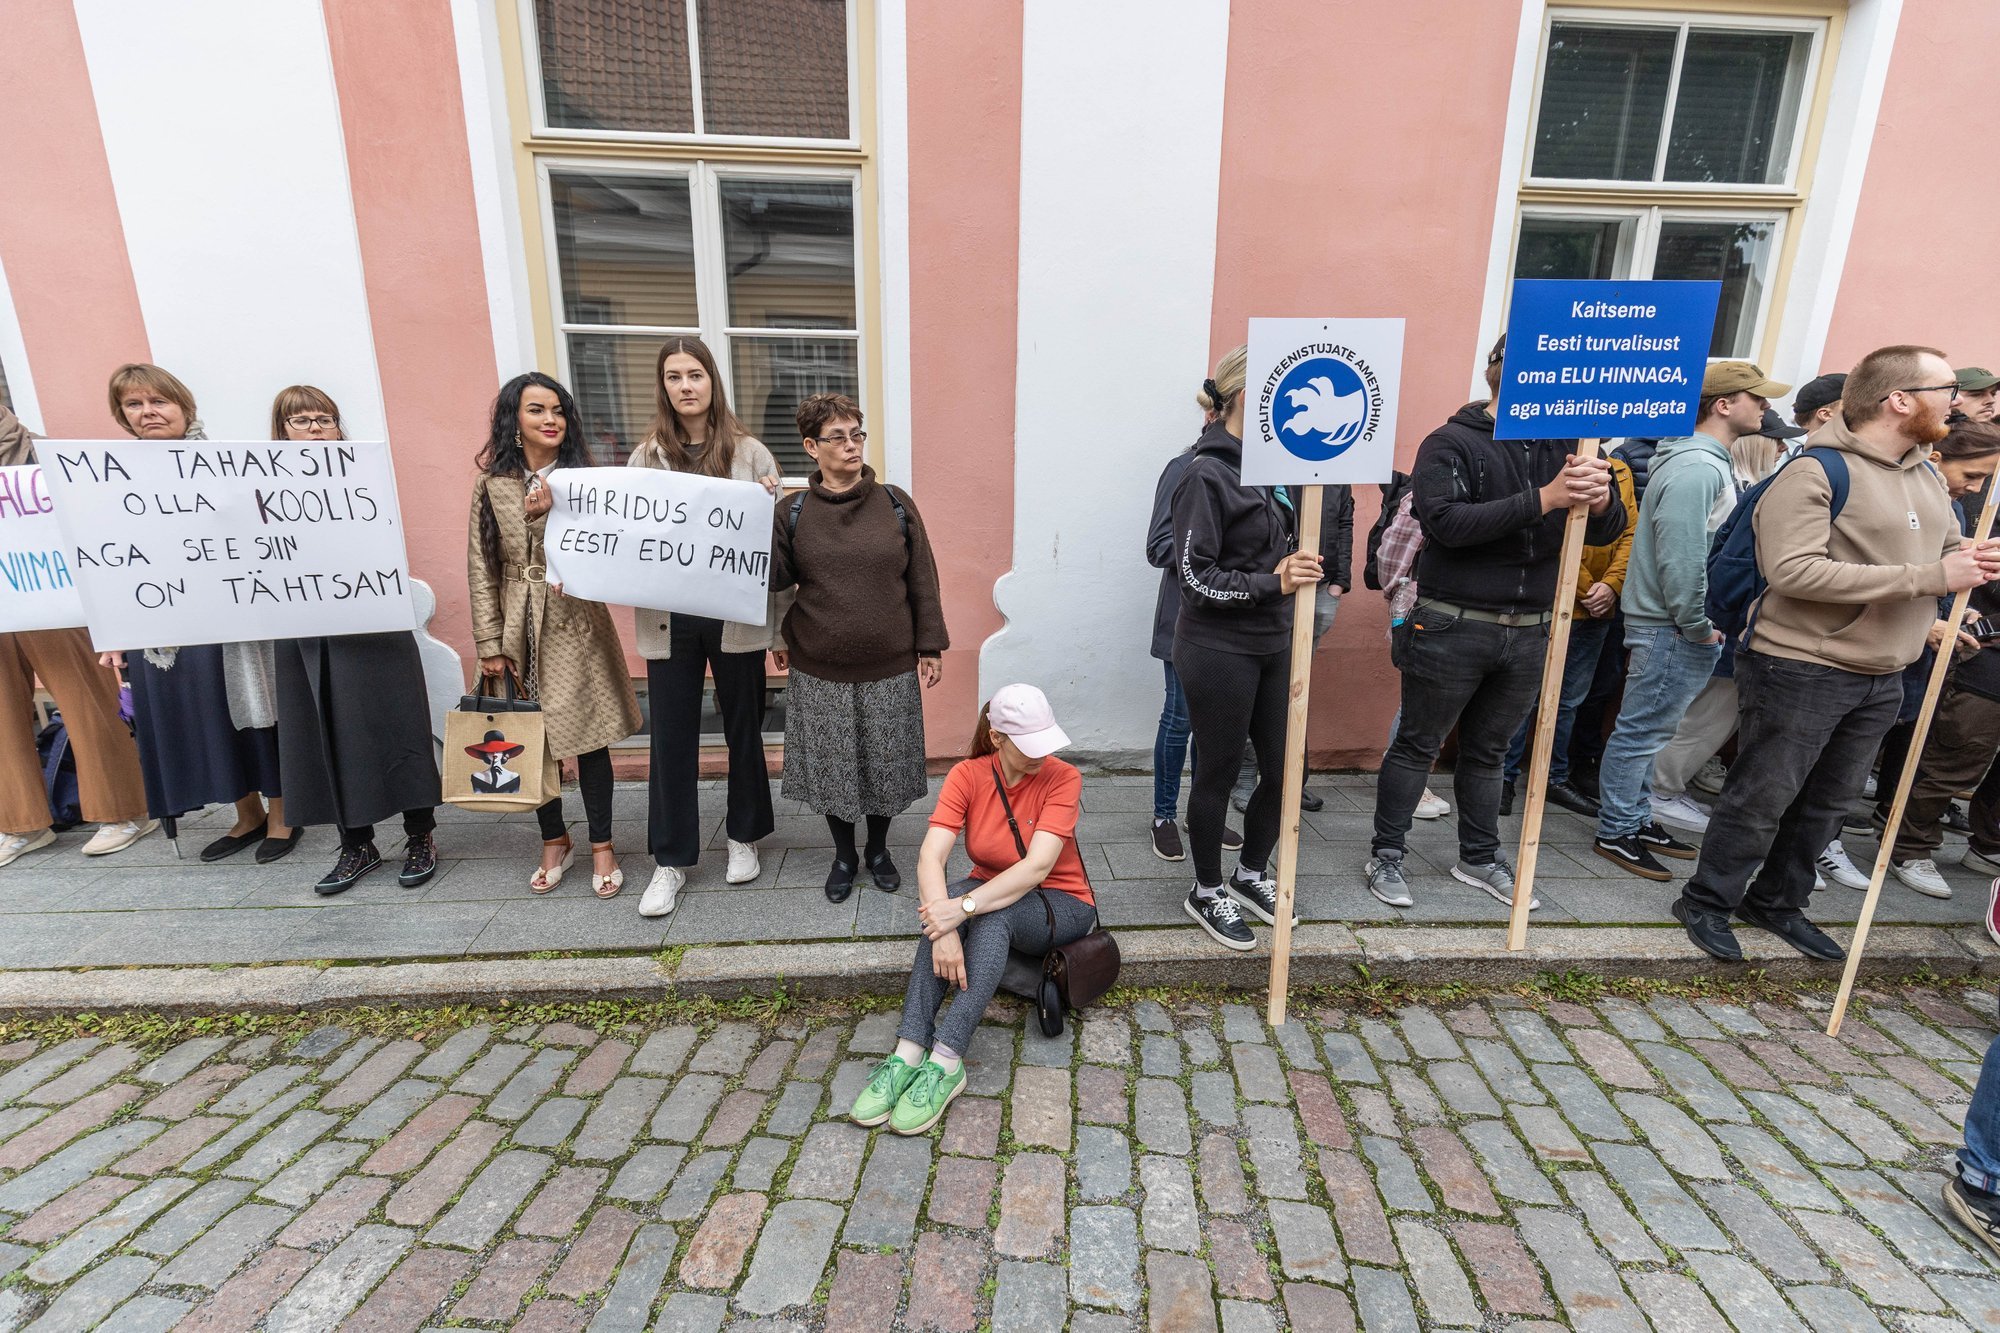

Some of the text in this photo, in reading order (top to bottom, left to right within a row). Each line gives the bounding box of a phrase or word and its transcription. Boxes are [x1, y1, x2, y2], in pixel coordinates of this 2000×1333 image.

[1572, 301, 1656, 318] Kaitseme
[1537, 335, 1680, 351] Eesti turvalisust
[1259, 343, 1384, 443] POLITSEITEENISTUJATE AMETIÜHING
[1518, 367, 1688, 386] oma ELU HINNAGA,
[1510, 399, 1686, 420] aga väärilise palgata
[57, 447, 355, 482] MA TAHAKSIN
[123, 487, 392, 525] OLLA KOOLIS,
[568, 482, 745, 531] HARIDUS ON
[77, 535, 298, 568] AGA SEE SIIN
[560, 528, 769, 587] EESTI EDU PANT!
[135, 569, 403, 609] ON TÄHTSAM
